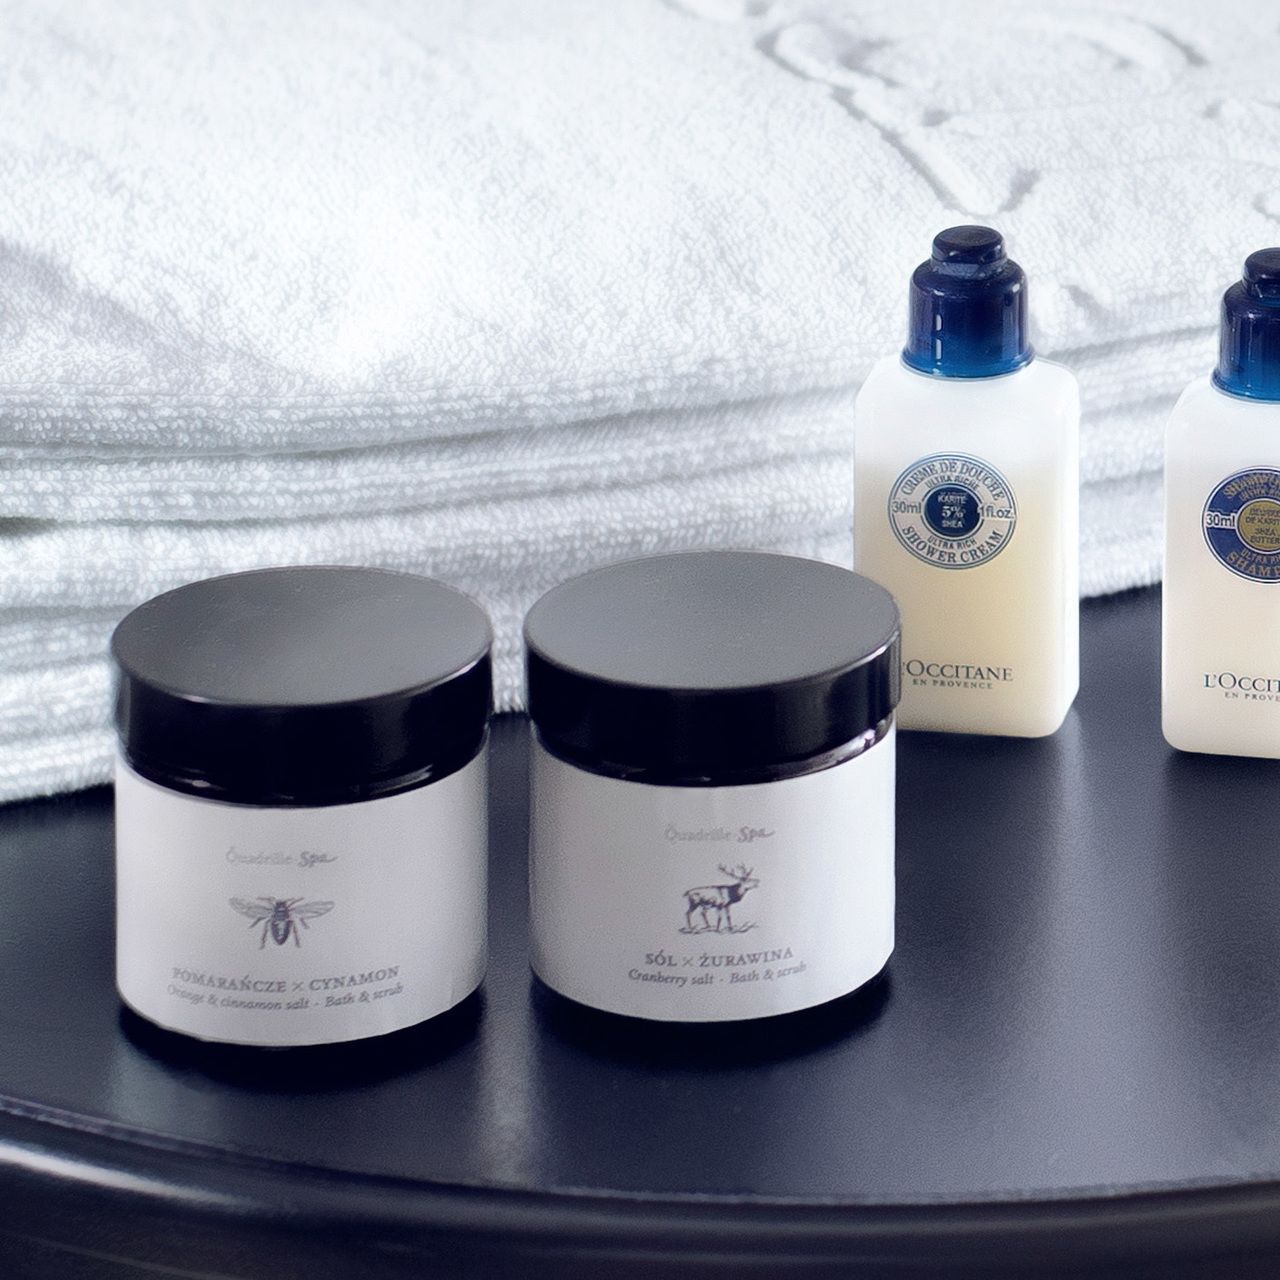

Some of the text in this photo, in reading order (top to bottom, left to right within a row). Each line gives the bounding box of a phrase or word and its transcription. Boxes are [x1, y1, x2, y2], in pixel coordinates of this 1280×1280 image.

[939, 461, 957, 474] DE
[960, 462, 1005, 501] DOUCHE
[892, 500, 921, 514] 30ml
[941, 506, 965, 518] 5%
[941, 520, 964, 529] SHEA
[1206, 513, 1236, 527] 30ml
[902, 526, 1004, 563] SHOWER CREAM
[928, 535, 977, 550] ULTRA RICH
[1250, 535, 1280, 545] BUTTER
[901, 659, 1013, 681] 'OCCITANE
[912, 678, 993, 689] EN PROVENCE
[1224, 691, 1239, 699] EN
[645, 949, 677, 967] SÓL
[698, 946, 793, 967] ŻURAWINA
[172, 967, 287, 993] POMARAŃCZE
[309, 965, 400, 991] CYNAMON
[628, 968, 688, 988] Cranberry
[691, 973, 714, 985] salt
[729, 970, 759, 984] Bath
[220, 996, 282, 1011] cinnamon
[286, 997, 310, 1010] salt
[324, 992, 354, 1008] Bath
